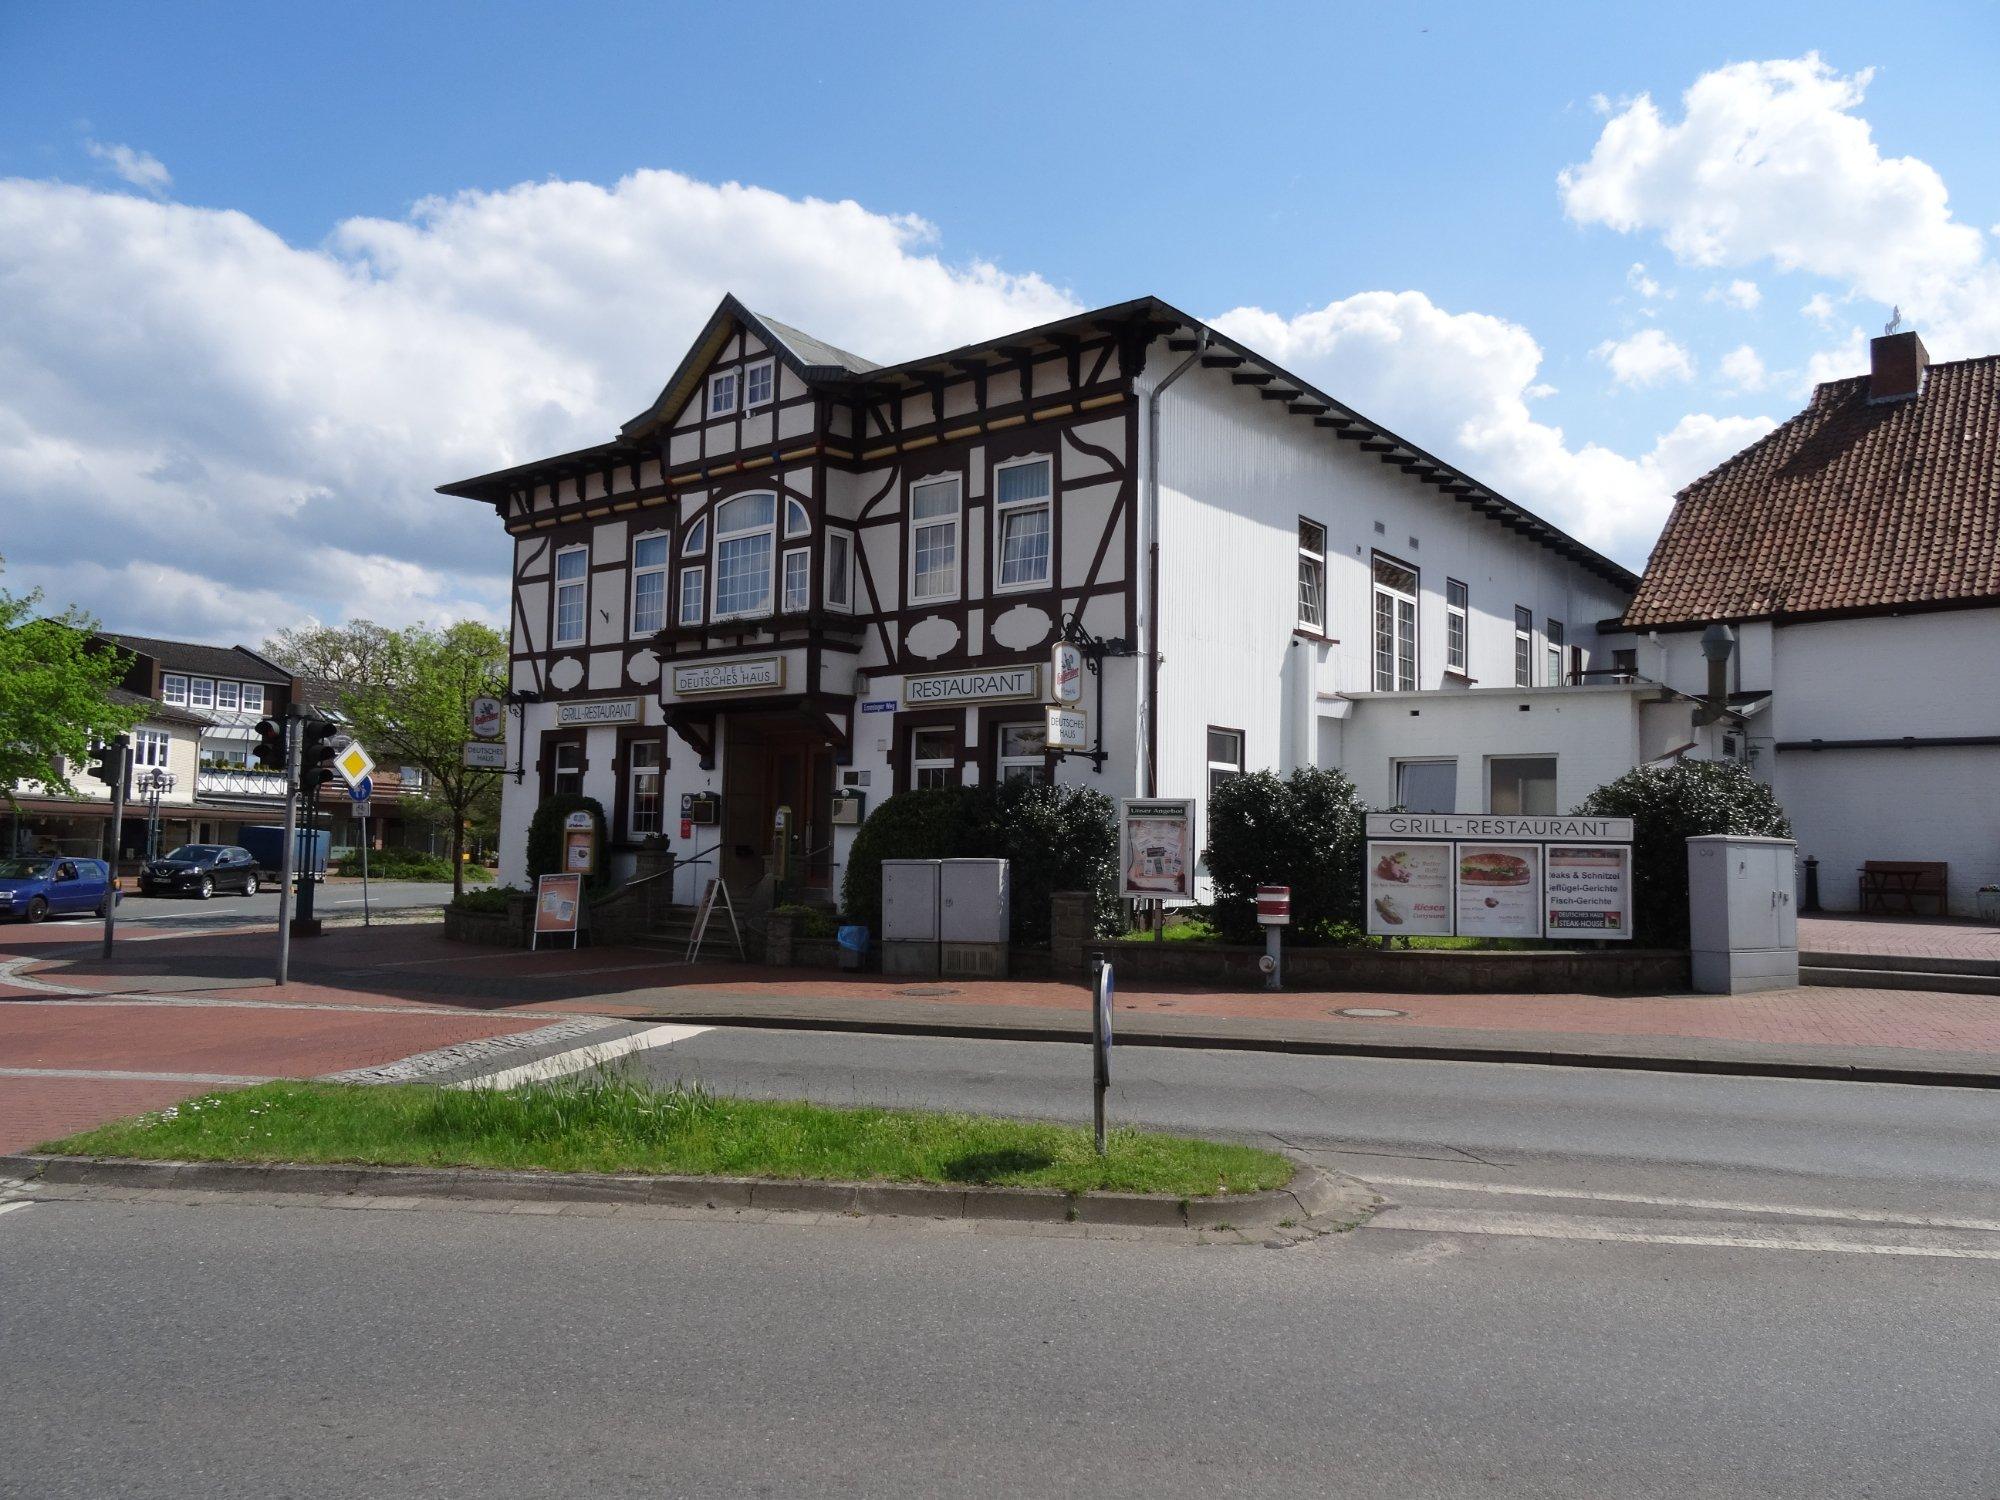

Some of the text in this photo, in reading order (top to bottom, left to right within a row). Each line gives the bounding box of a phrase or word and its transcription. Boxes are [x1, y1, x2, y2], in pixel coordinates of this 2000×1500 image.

[703, 665, 745, 676] HOTEL
[680, 671, 770, 689] DEUTSCHES HAUS
[912, 673, 1025, 699] RESTAURANT
[561, 703, 632, 721] GRILL-RESTAURANT
[1051, 717, 1085, 729] DEUTSCHES
[1060, 729, 1076, 739] HAUS
[467, 746, 504, 755] DEUTSCHES
[1153, 807, 1184, 816] Angebot
[1389, 818, 1611, 837] GRILL-RESTAURANT
[1573, 871, 1579, 880] &
[1581, 871, 1621, 880] Schnitzel
[1550, 896, 1612, 905] Fisch-Gerichte
[1559, 920, 1605, 928] STEAK-HOUSE
